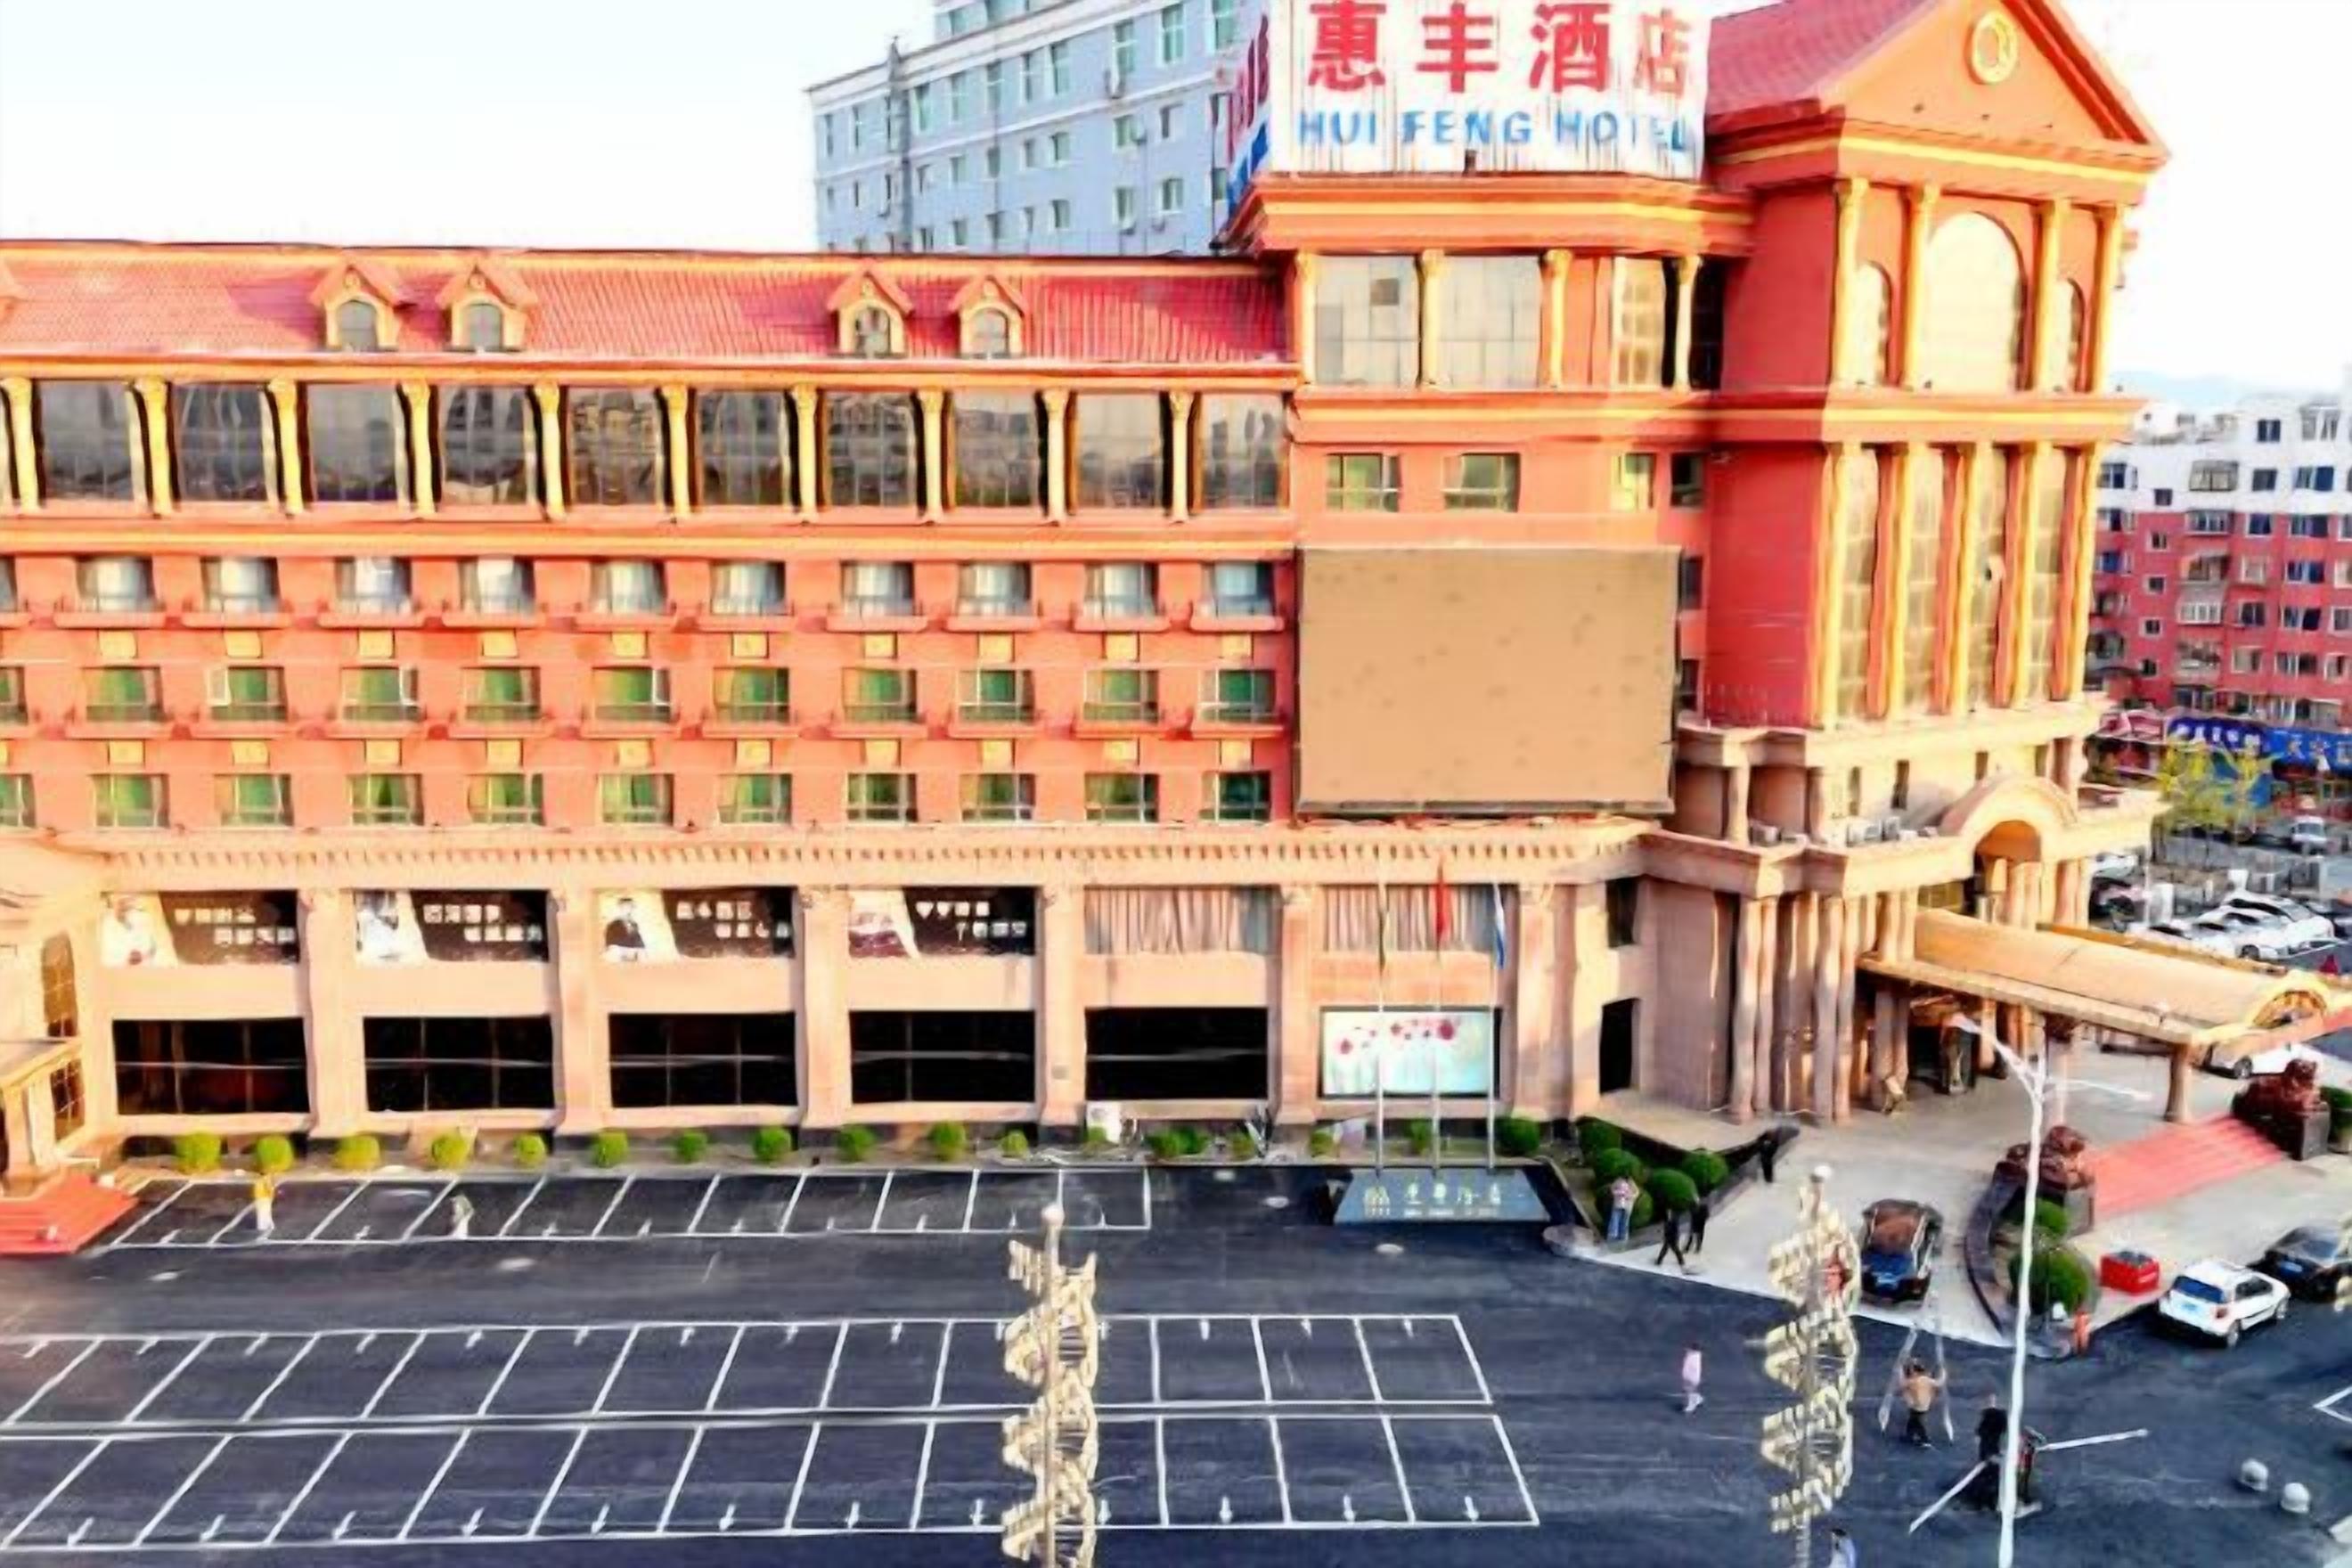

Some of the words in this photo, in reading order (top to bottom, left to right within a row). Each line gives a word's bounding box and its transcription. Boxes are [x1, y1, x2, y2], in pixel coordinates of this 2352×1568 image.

[1309, 0, 1692, 97] 惠丰酒店
[1300, 110, 1376, 145] HUI
[1403, 110, 1531, 144] FENG
